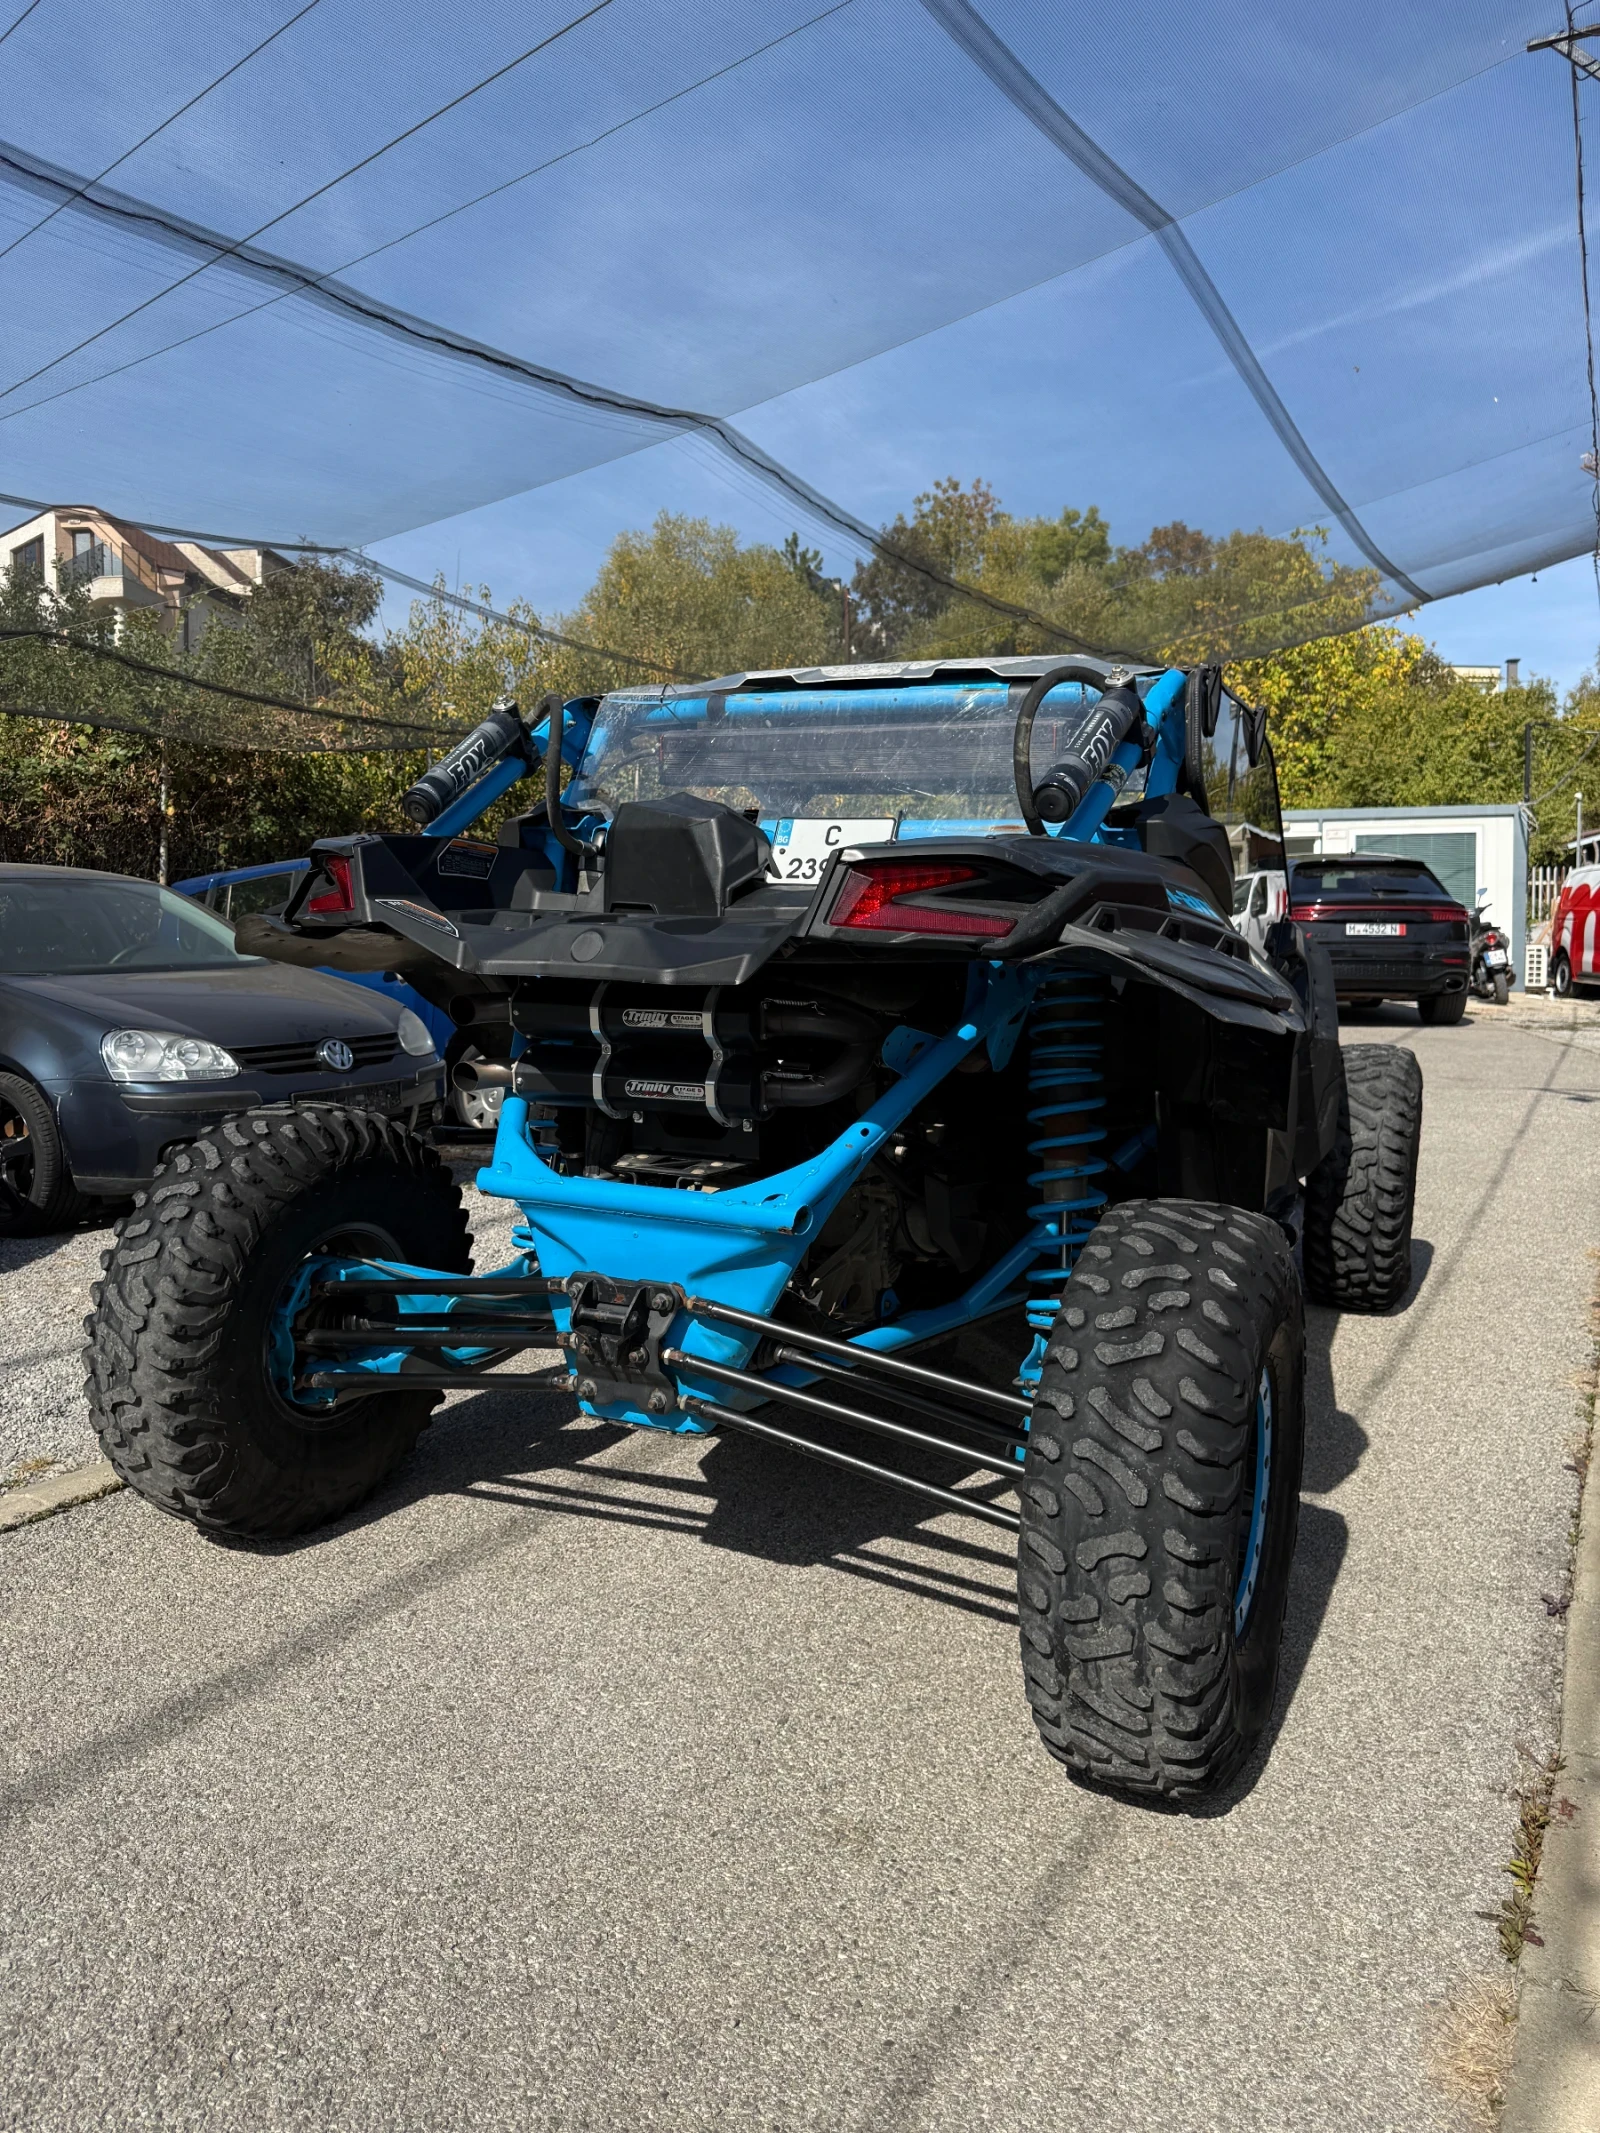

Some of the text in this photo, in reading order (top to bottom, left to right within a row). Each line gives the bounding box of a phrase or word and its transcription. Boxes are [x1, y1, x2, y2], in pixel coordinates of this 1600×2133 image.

[1080, 717, 1119, 779] FOX
[446, 738, 488, 792] FOX
[777, 835, 789, 844] BG
[824, 825, 842, 846] C
[1348, 923, 1397, 935] M 4532 N
[627, 1011, 668, 1023] Trinity
[630, 1081, 671, 1094] Trinity
